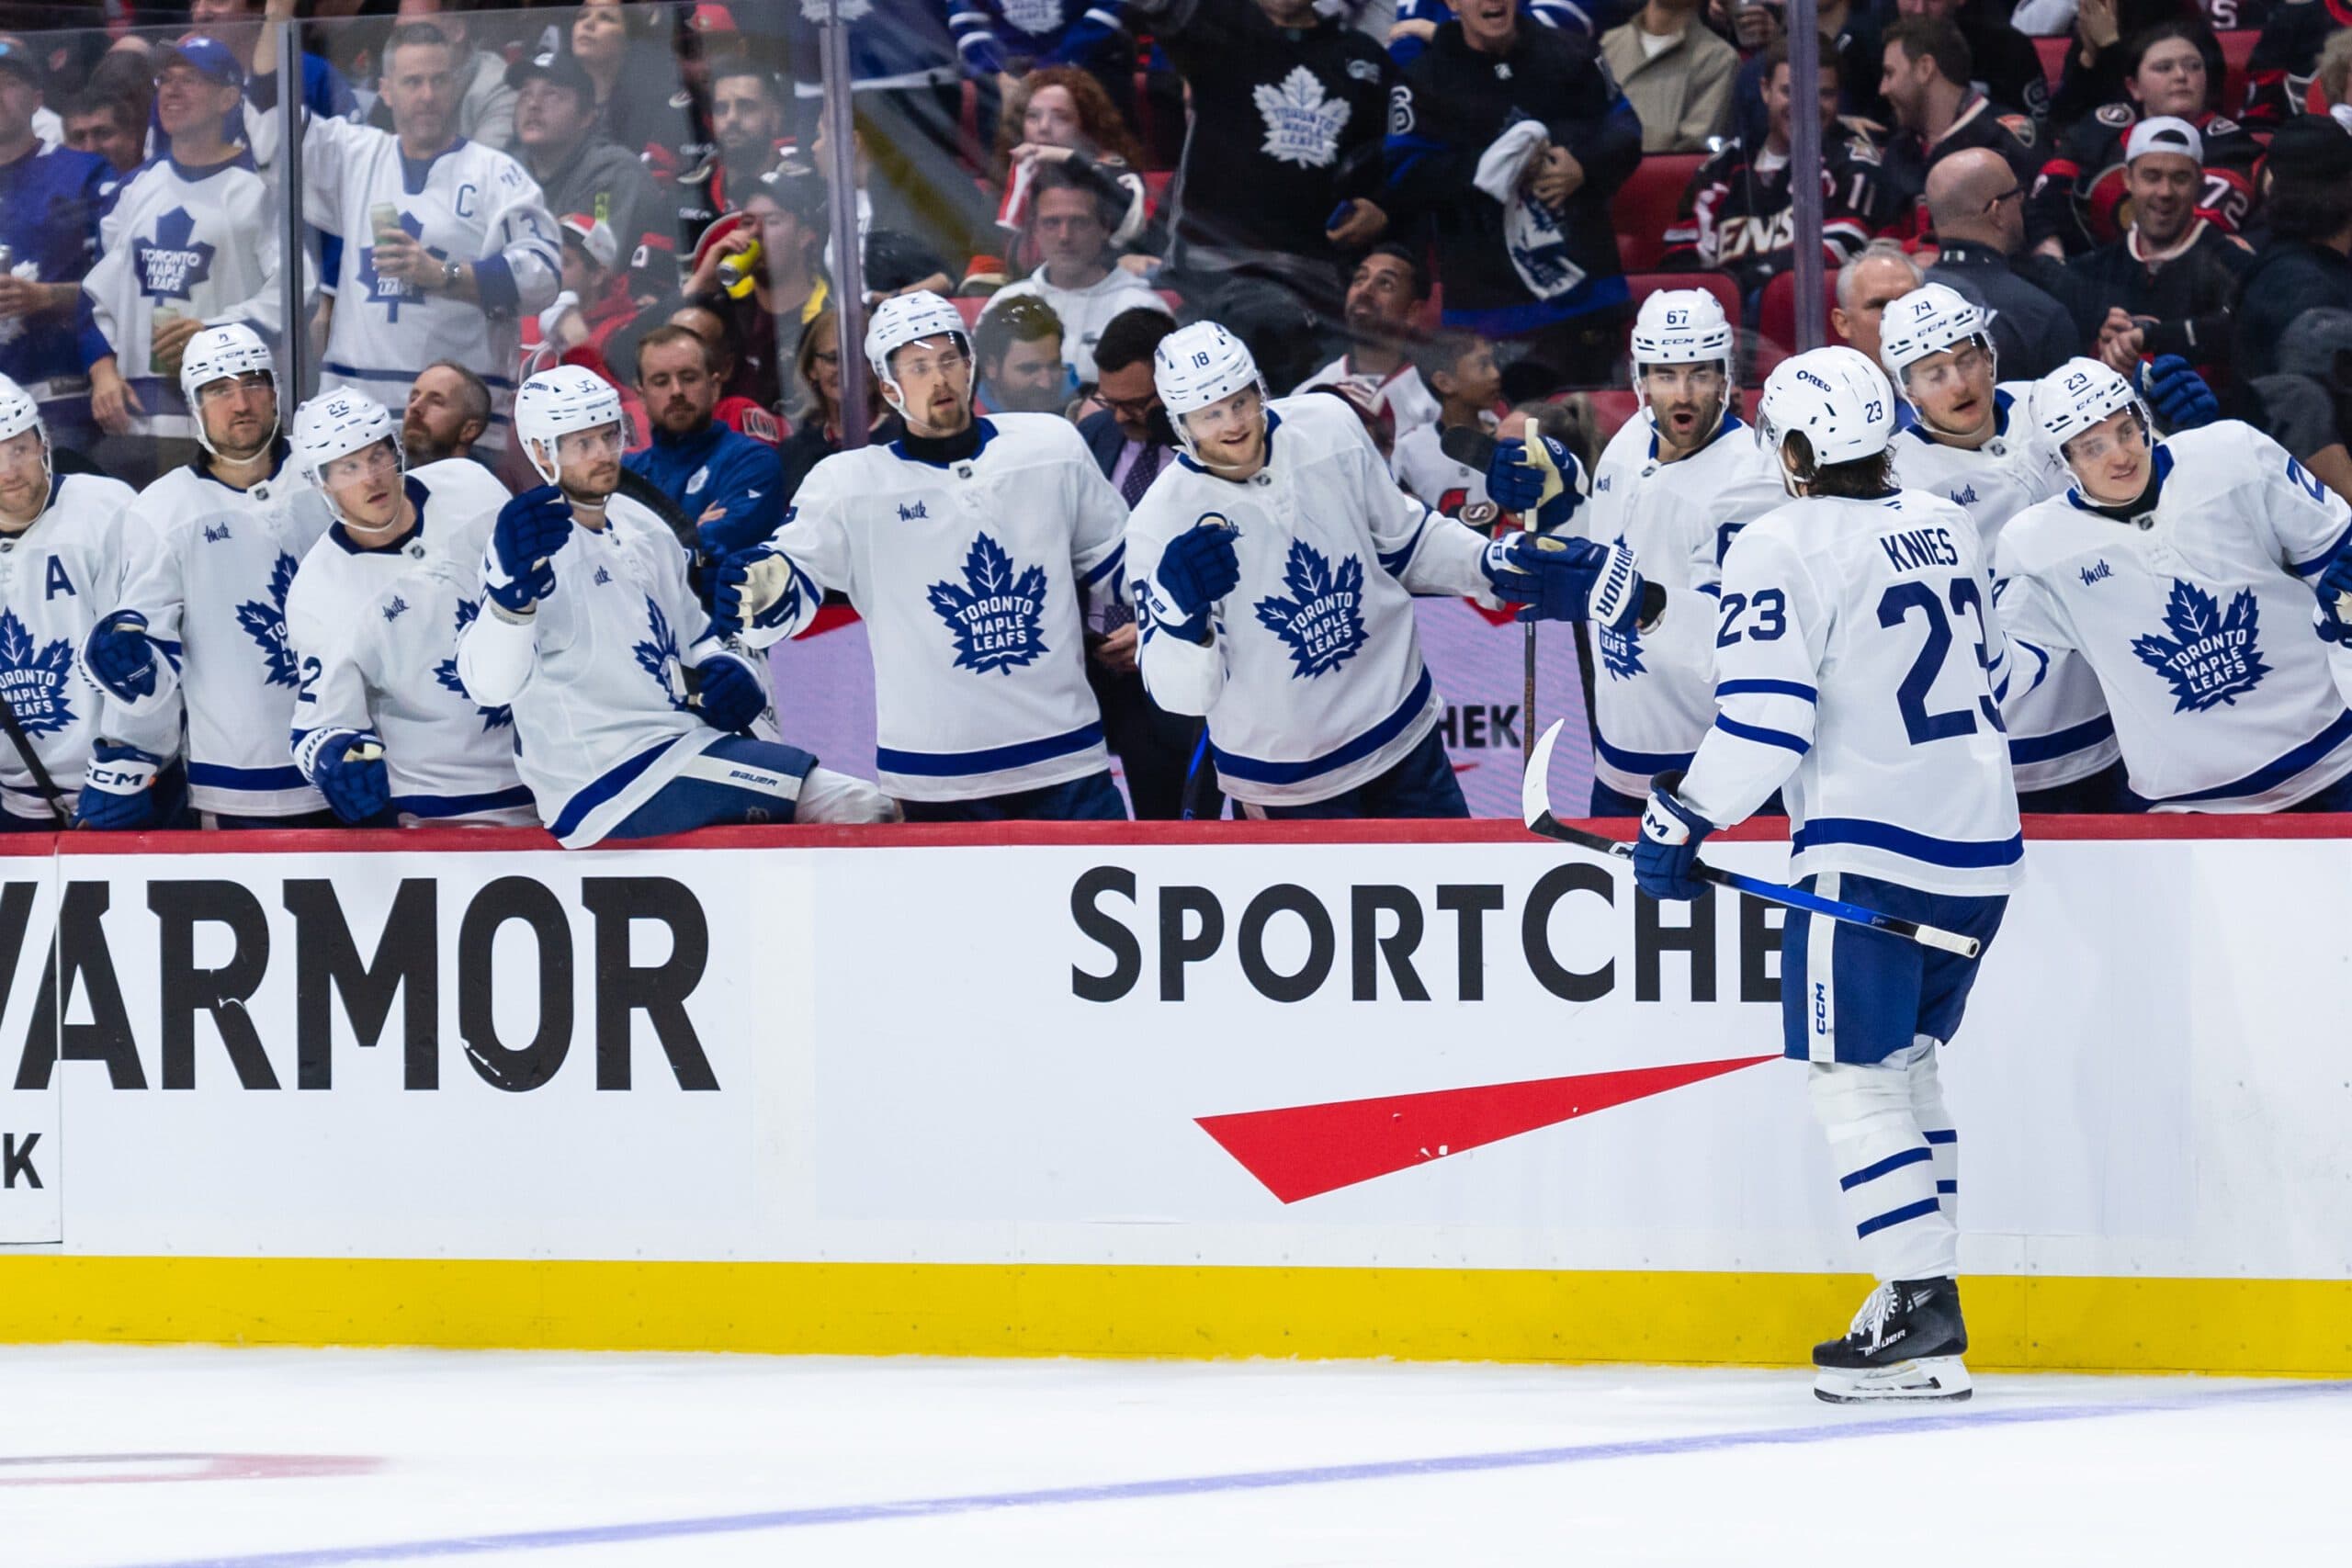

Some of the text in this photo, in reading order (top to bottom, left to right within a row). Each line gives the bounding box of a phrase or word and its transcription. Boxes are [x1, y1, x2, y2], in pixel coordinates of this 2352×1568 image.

[456, 184, 476, 218] C
[141, 248, 200, 267] TORONTO
[146, 263, 187, 279] MAPLE
[147, 276, 181, 291] LEAFS
[1667, 310, 1689, 324] 67
[1192, 352, 1210, 368] 18
[1796, 370, 1832, 392] OREO
[326, 400, 349, 415] 22
[1865, 400, 1883, 423] 23
[897, 500, 930, 522] milk
[1880, 528, 1959, 572] KNIES
[46, 555, 77, 601] A
[2079, 558, 2114, 586] milk
[955, 596, 1034, 625] TORONTO
[1286, 592, 1352, 634] TORONTO
[1716, 588, 1787, 649] 23
[971, 614, 1025, 636] MAPLE
[1302, 608, 1349, 643] MAPLE
[973, 630, 1027, 651] LEAFS
[1306, 625, 1352, 658] LEAFS
[2165, 628, 2247, 671] TORONTO
[1876, 578, 2007, 746] 23
[2184, 646, 2242, 680] MAPLE
[0, 669, 57, 690] ORONTO
[299, 656, 322, 705] 2
[2190, 660, 2247, 694] LEAFS
[2, 685, 50, 704] MAPLE
[14, 700, 54, 716] EAFS
[1440, 705, 1521, 749] HEK
[729, 770, 778, 787] BAUER
[1815, 983, 1826, 1035] CCM
